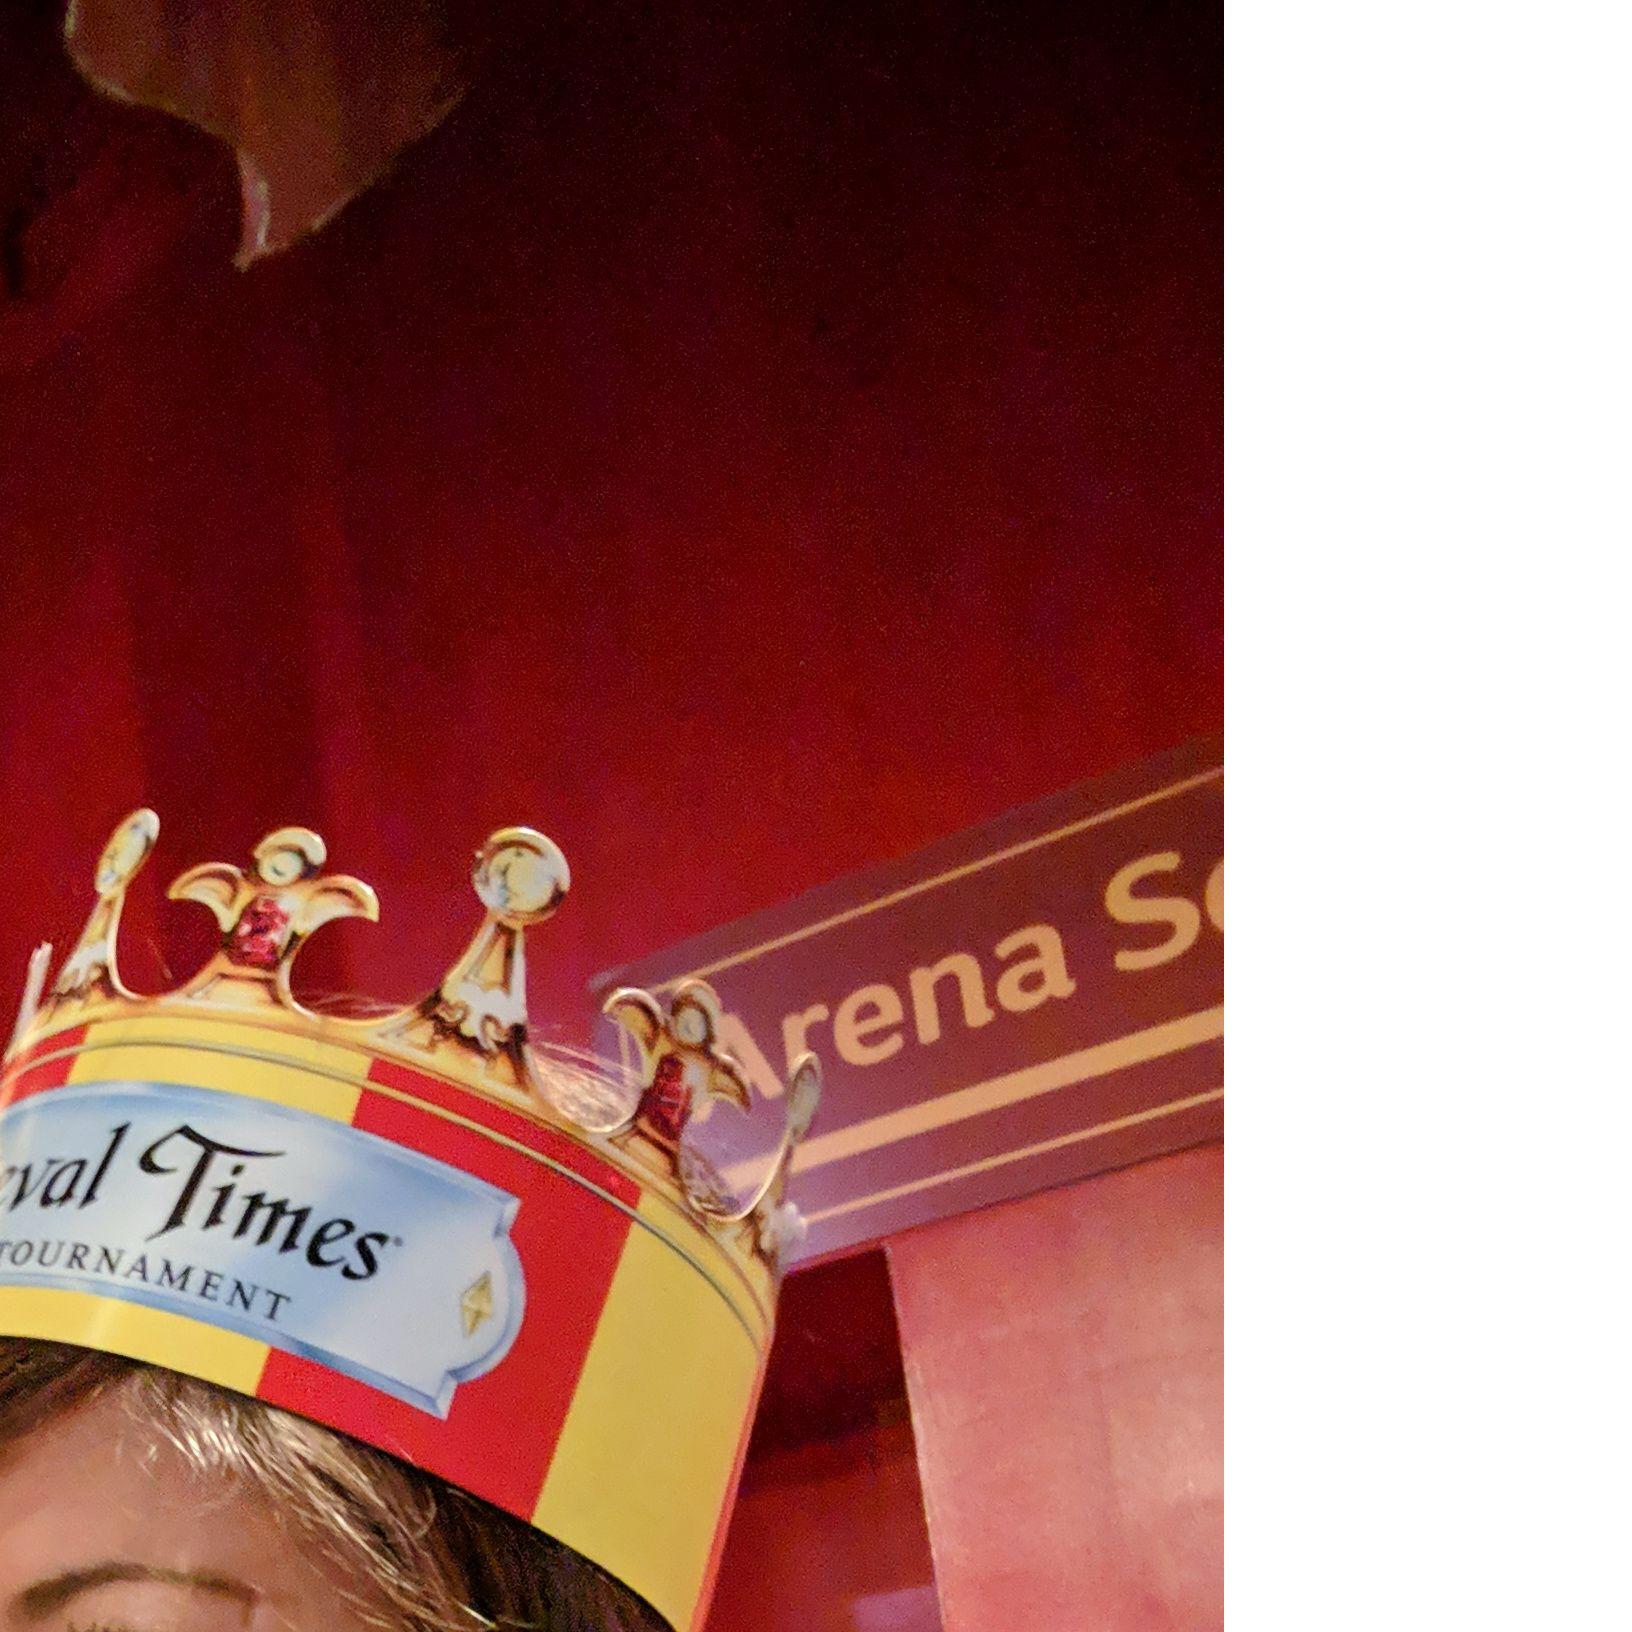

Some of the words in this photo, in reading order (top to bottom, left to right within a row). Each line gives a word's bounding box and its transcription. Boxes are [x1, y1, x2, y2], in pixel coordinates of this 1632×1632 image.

[686, 923, 1077, 1124] Arena
[1104, 850, 1224, 971] S
[139, 1123, 390, 1282] Times
